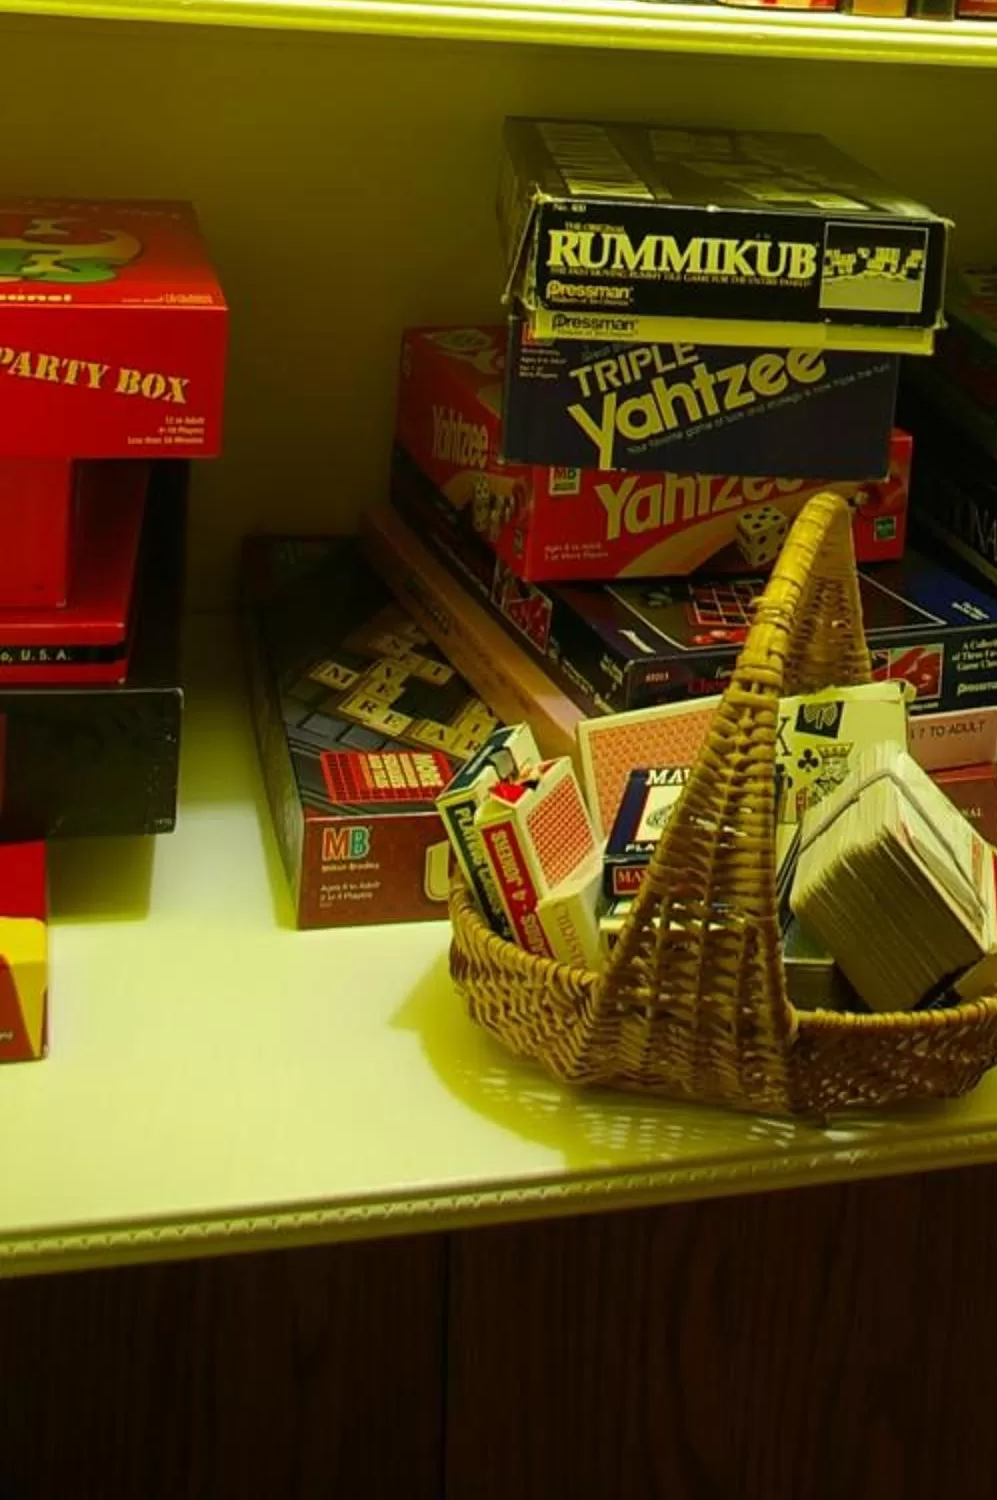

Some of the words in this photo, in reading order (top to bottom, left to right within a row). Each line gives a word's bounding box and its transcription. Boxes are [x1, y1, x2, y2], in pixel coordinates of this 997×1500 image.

[546, 279, 630, 300] Pressman
[552, 312, 636, 331] Pressman
[0, 347, 110, 389] PARTY
[115, 367, 190, 404] BOX
[568, 341, 699, 398] TRIPLE
[567, 347, 827, 471] Yahtzee
[947, 720, 985, 736] ADULT
[321, 825, 370, 862] MB
